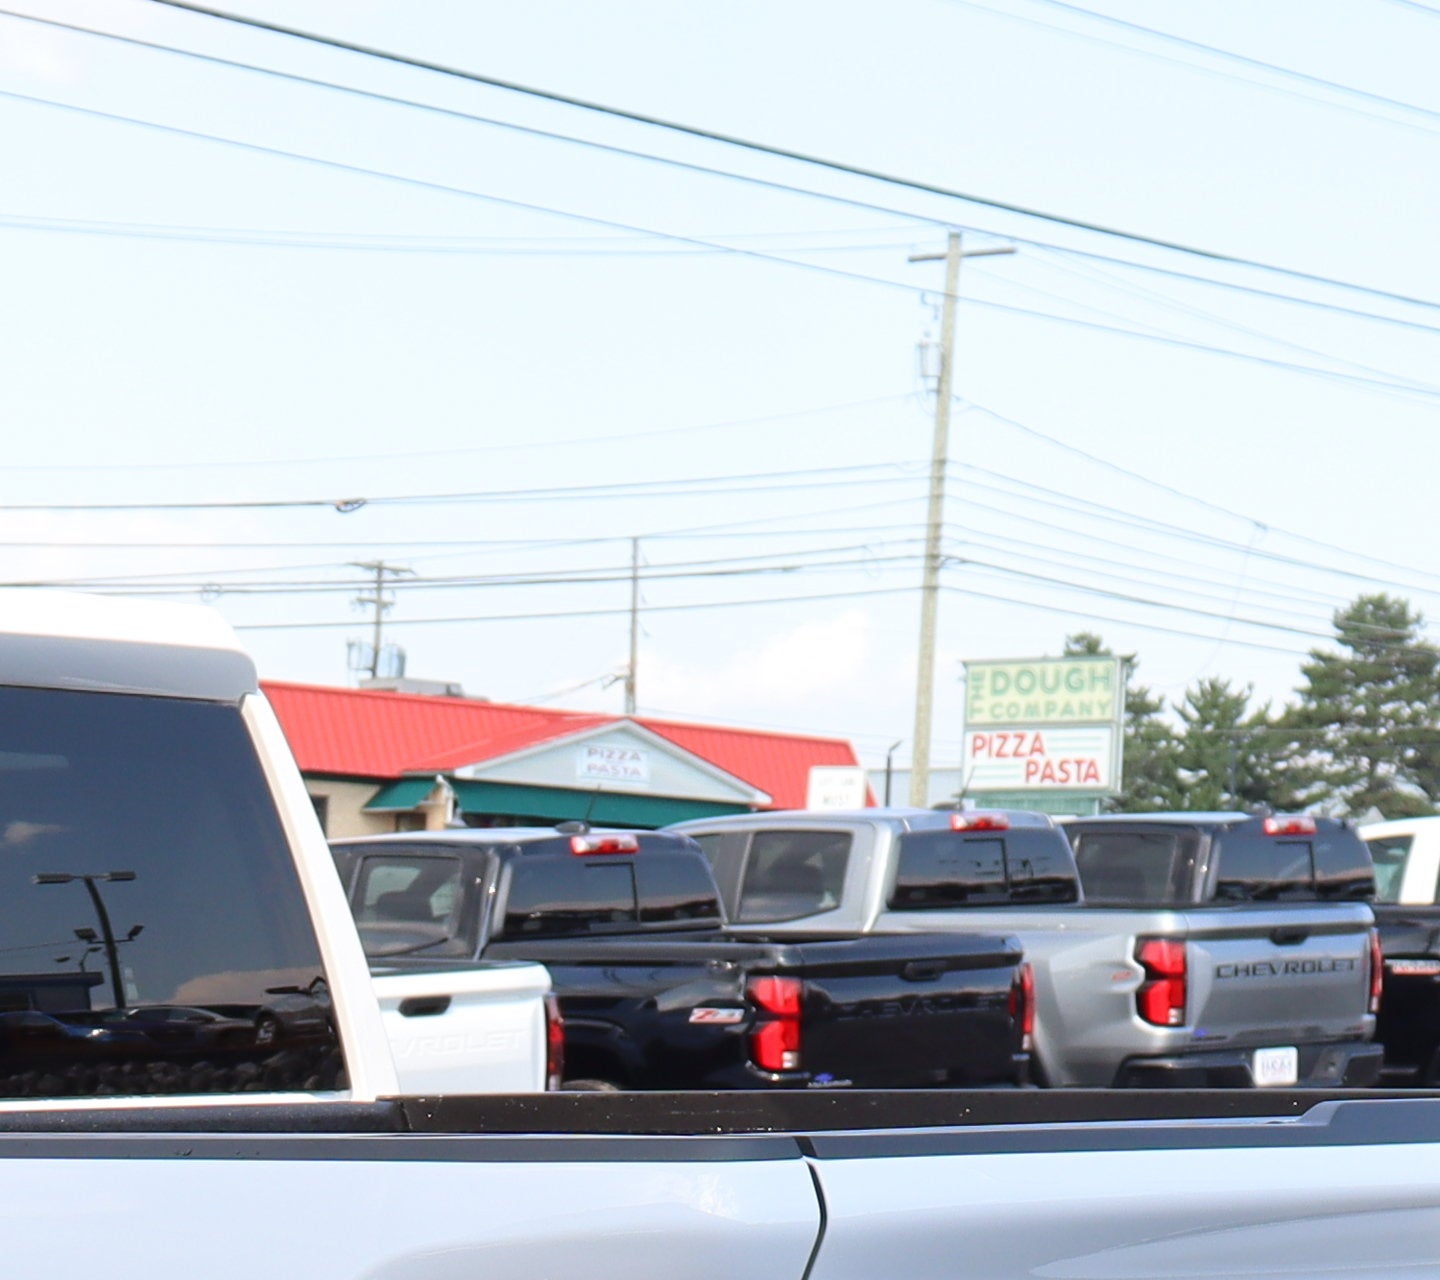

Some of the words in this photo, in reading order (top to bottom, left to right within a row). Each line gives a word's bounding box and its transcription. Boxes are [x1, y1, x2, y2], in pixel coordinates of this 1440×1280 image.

[990, 664, 1112, 696] DOUGH
[989, 701, 1111, 719] COMPANY
[588, 747, 641, 761] PIZZA
[972, 732, 1045, 758] PIZZA
[587, 762, 641, 776] PASTA
[1026, 758, 1100, 784] PASTA
[1216, 957, 1356, 980] CHEVROLET
